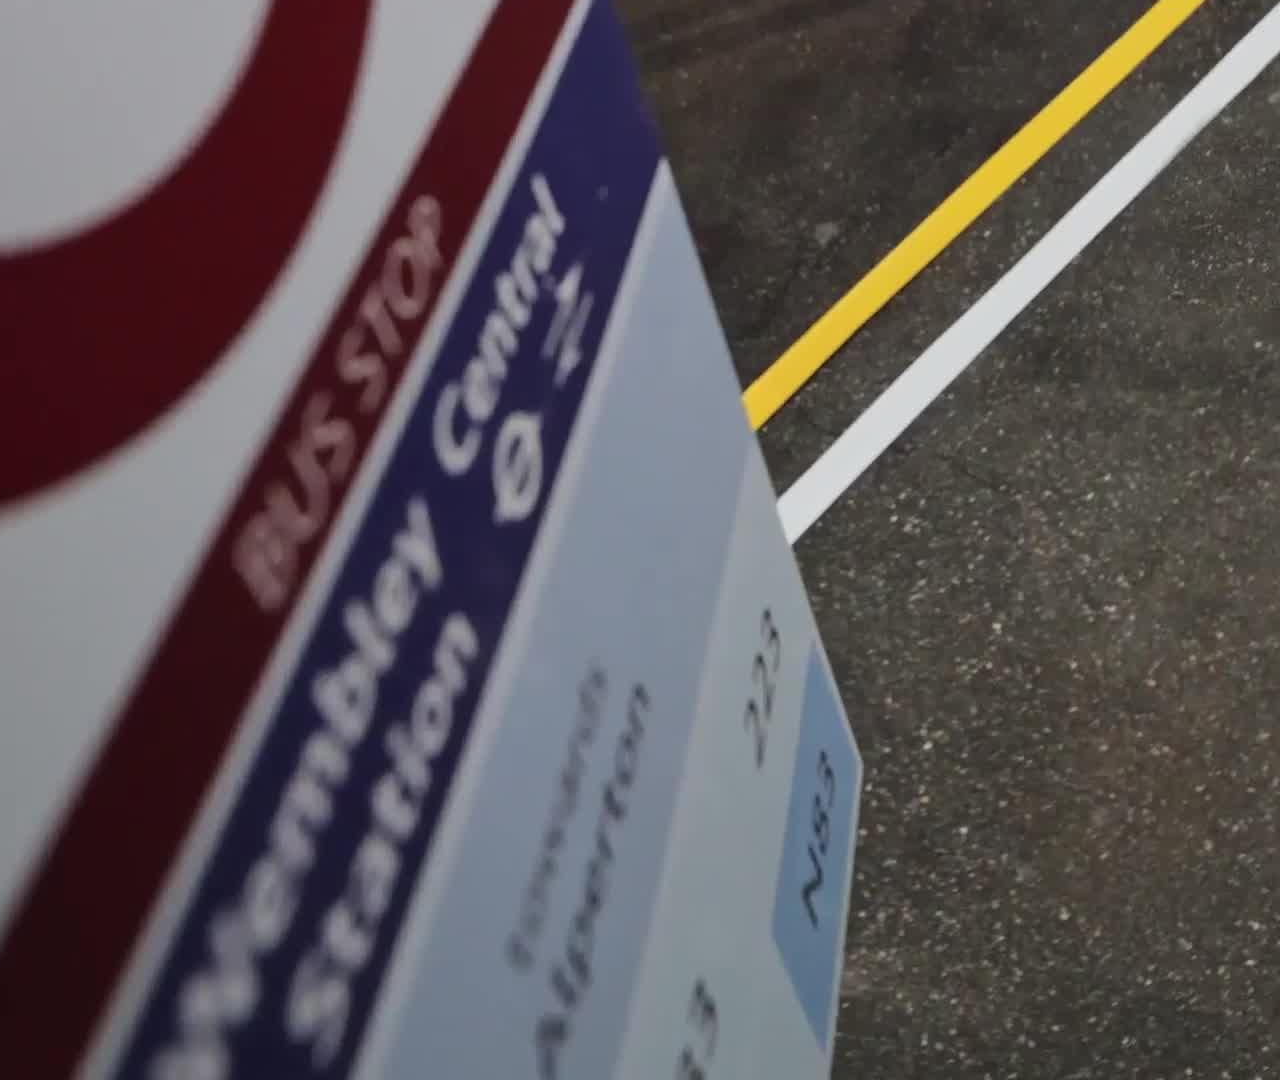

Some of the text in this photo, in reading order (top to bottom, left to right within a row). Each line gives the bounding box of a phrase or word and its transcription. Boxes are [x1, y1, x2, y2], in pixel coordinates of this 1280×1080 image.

[230, 192, 446, 614] BUS STOP
[142, 171, 567, 1080] Wembley Central
[742, 606, 783, 770] 223
[282, 610, 480, 1072] Station
[800, 748, 837, 931] N83
